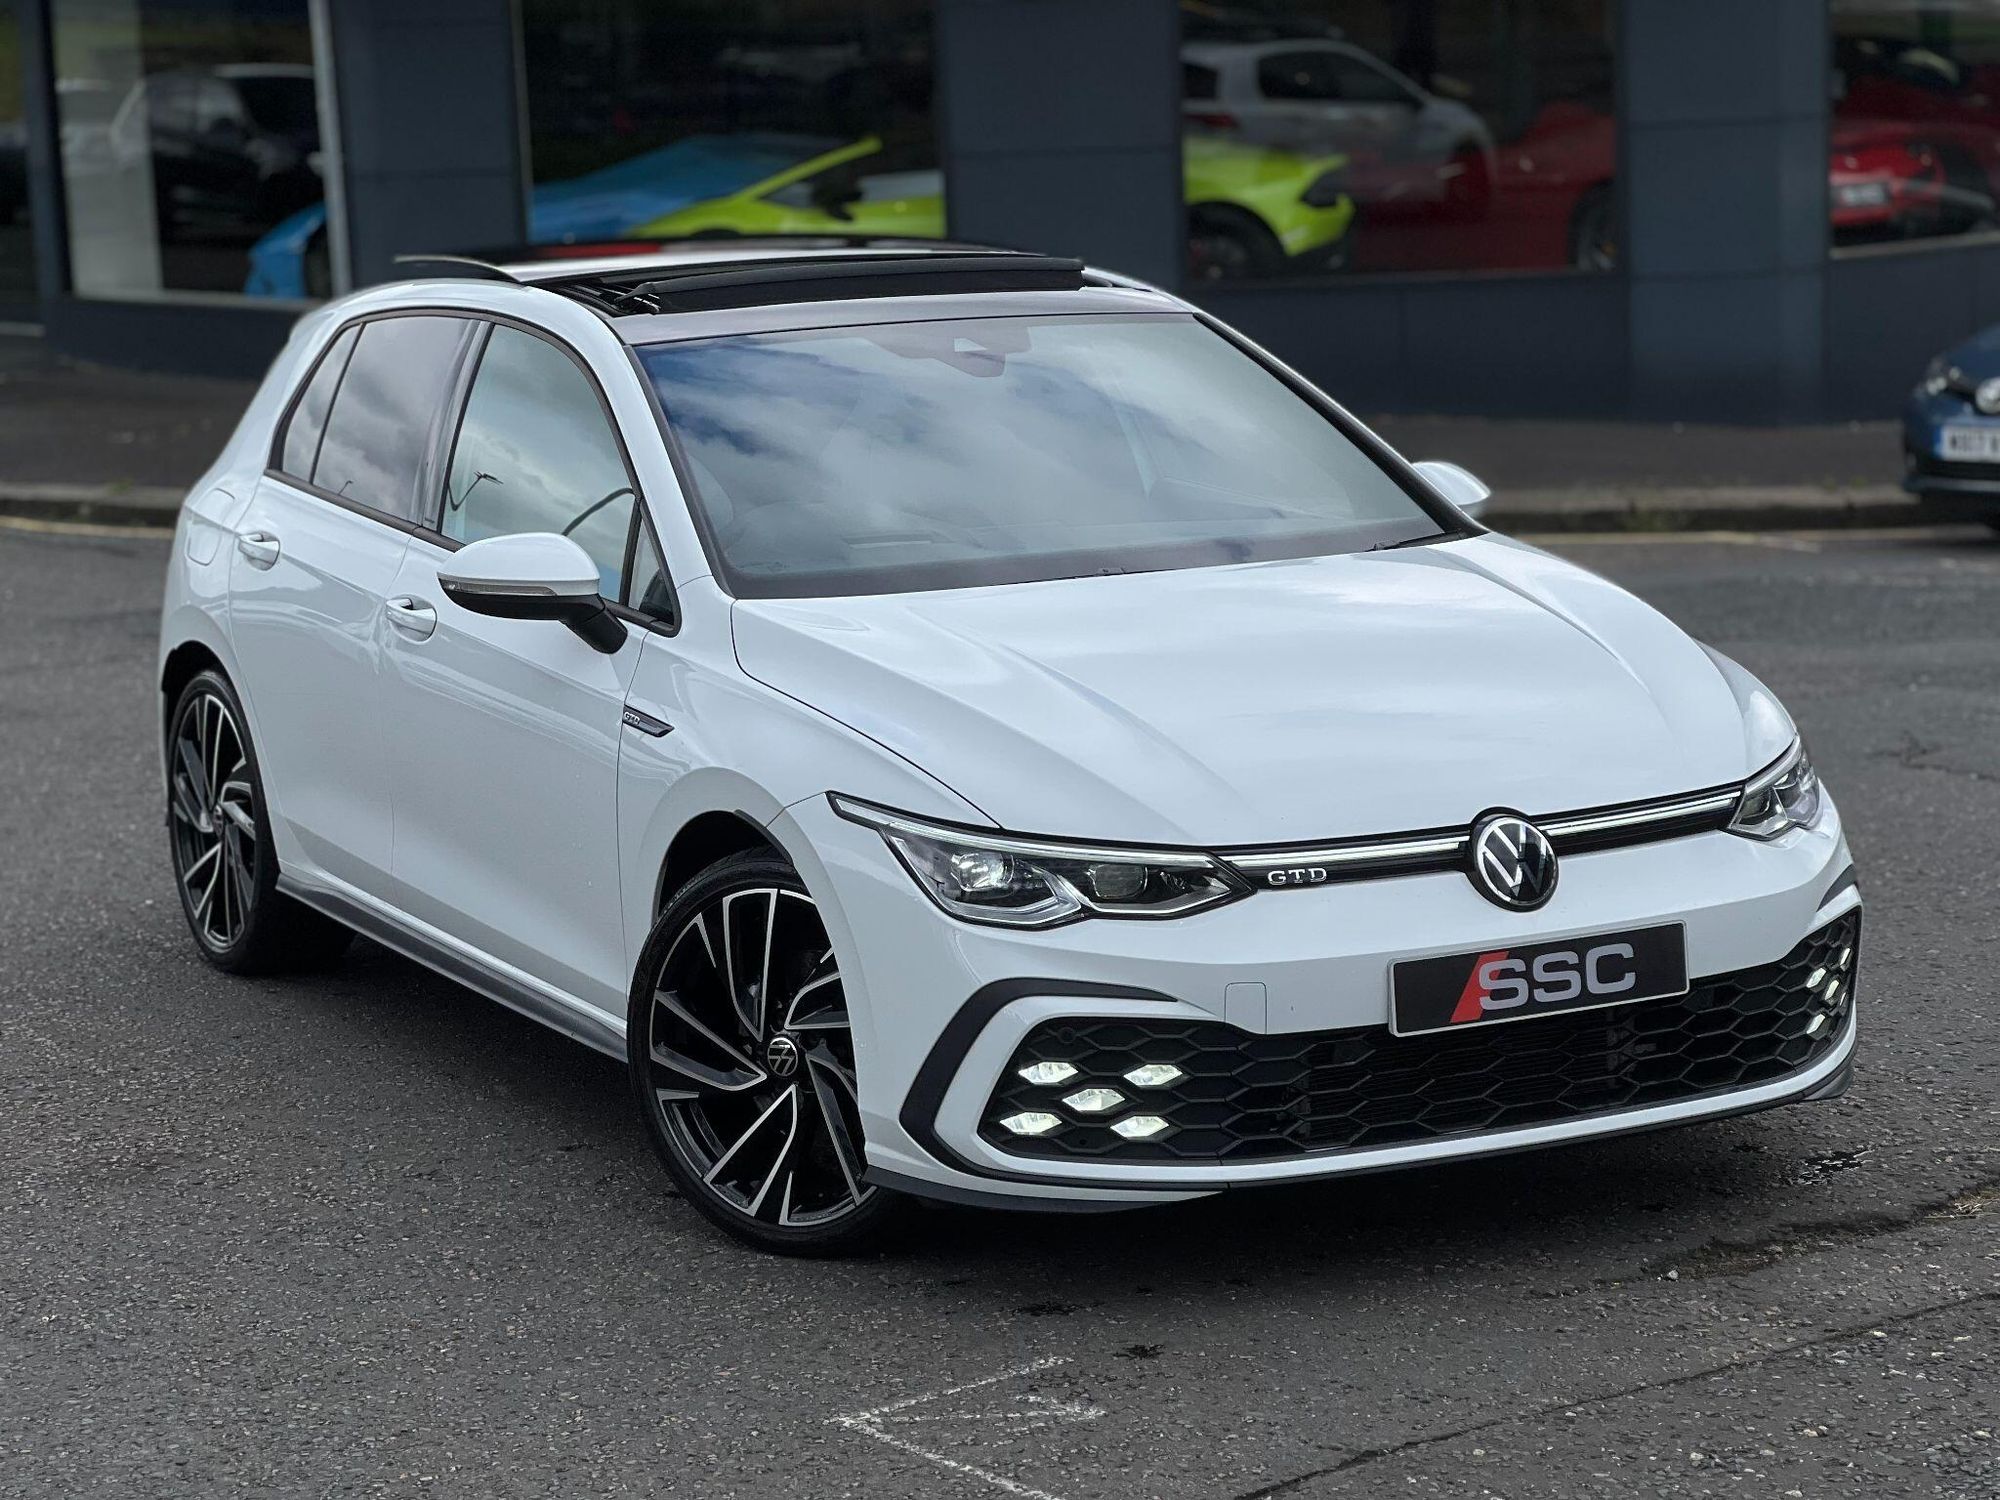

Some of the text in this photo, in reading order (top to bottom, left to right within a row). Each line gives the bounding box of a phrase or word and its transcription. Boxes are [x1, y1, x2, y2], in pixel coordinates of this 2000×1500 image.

[624, 711, 640, 725] GTD
[1267, 867, 1327, 885] GTD
[1479, 942, 1636, 1011] SSC
